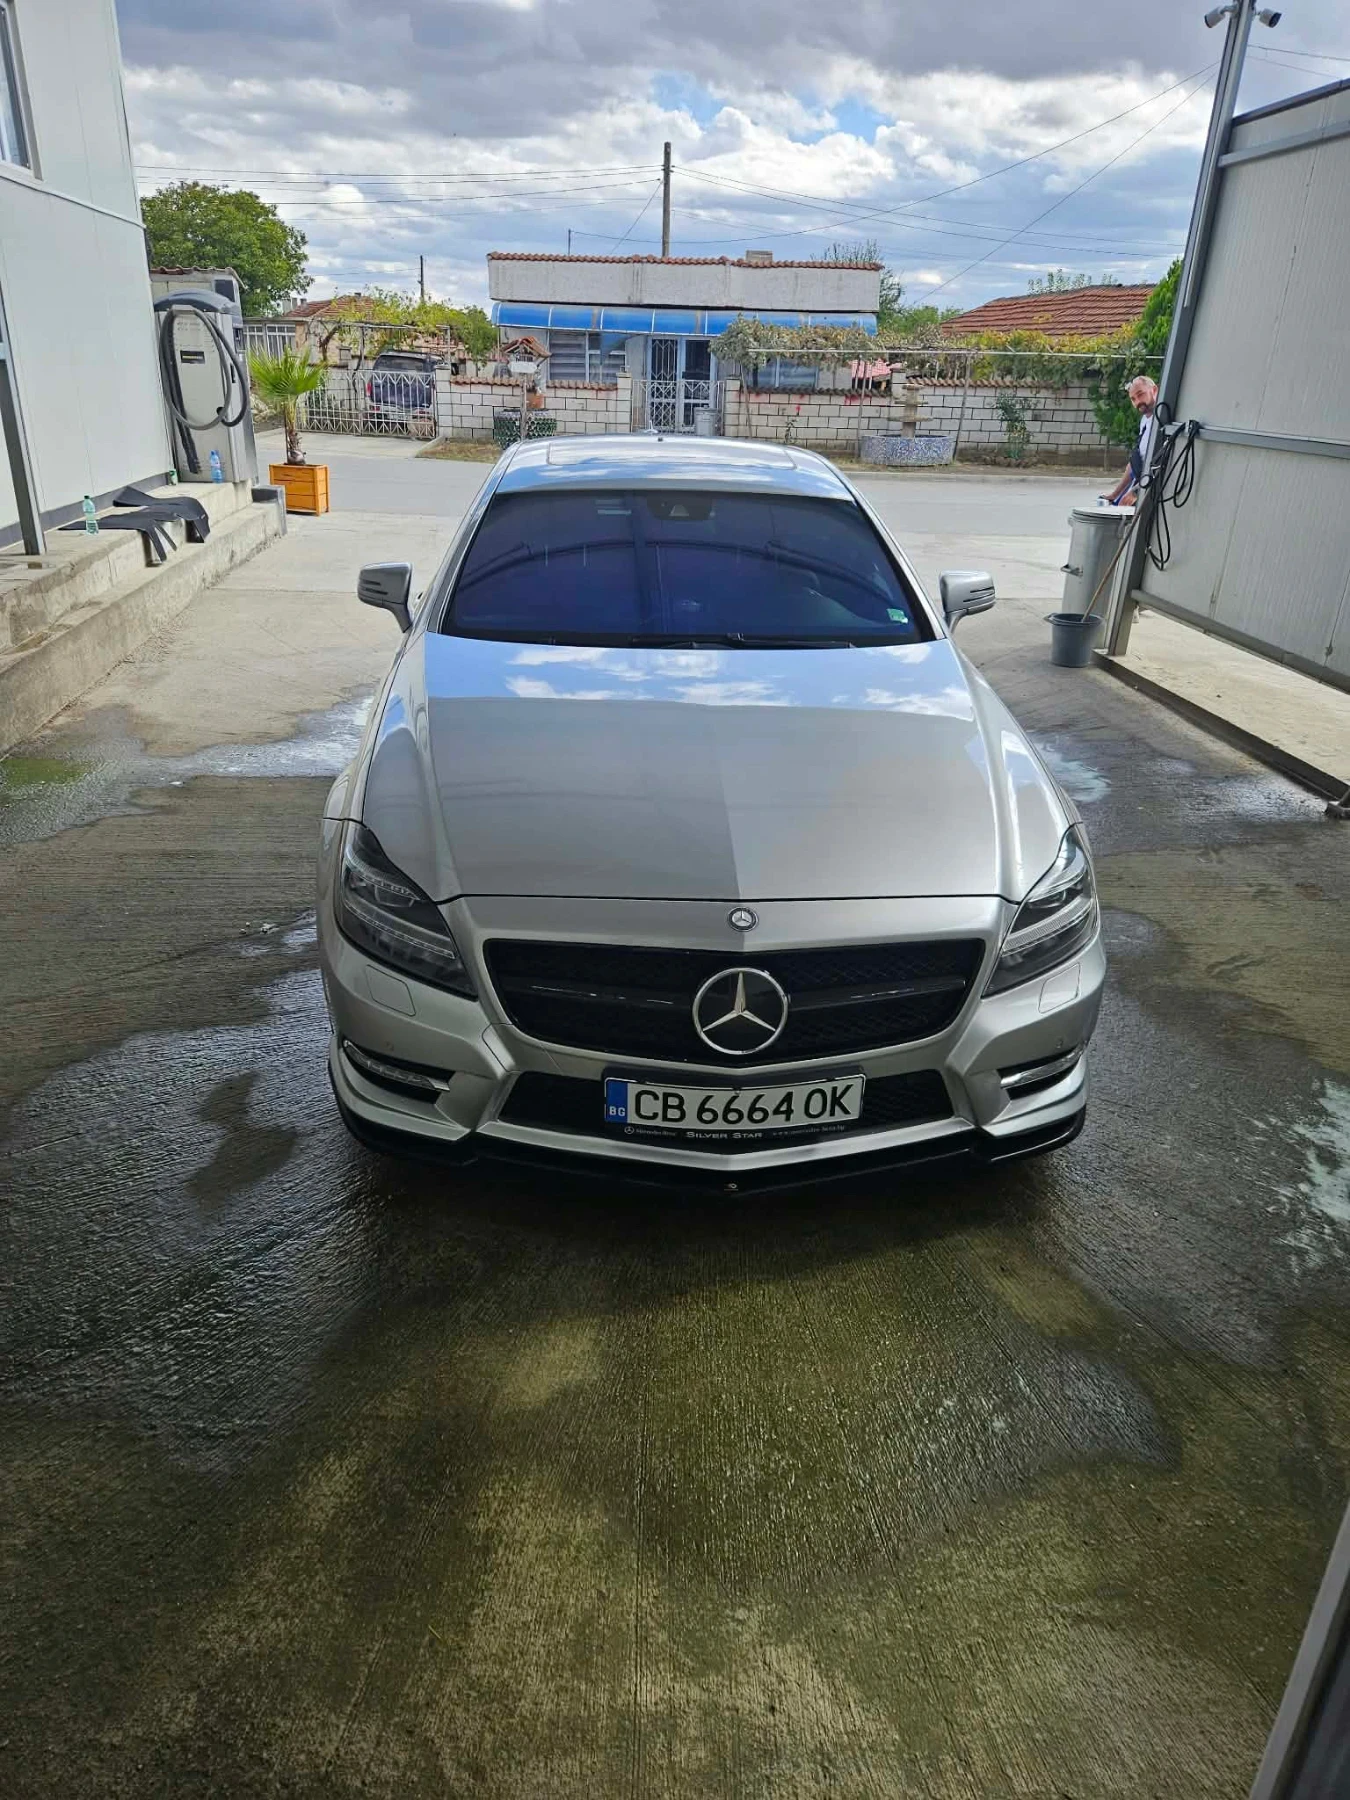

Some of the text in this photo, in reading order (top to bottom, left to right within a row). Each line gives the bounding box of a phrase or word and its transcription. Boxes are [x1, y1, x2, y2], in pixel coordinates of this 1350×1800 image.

[609, 1105, 626, 1117] BG
[634, 1084, 854, 1125] CB 6664 OK
